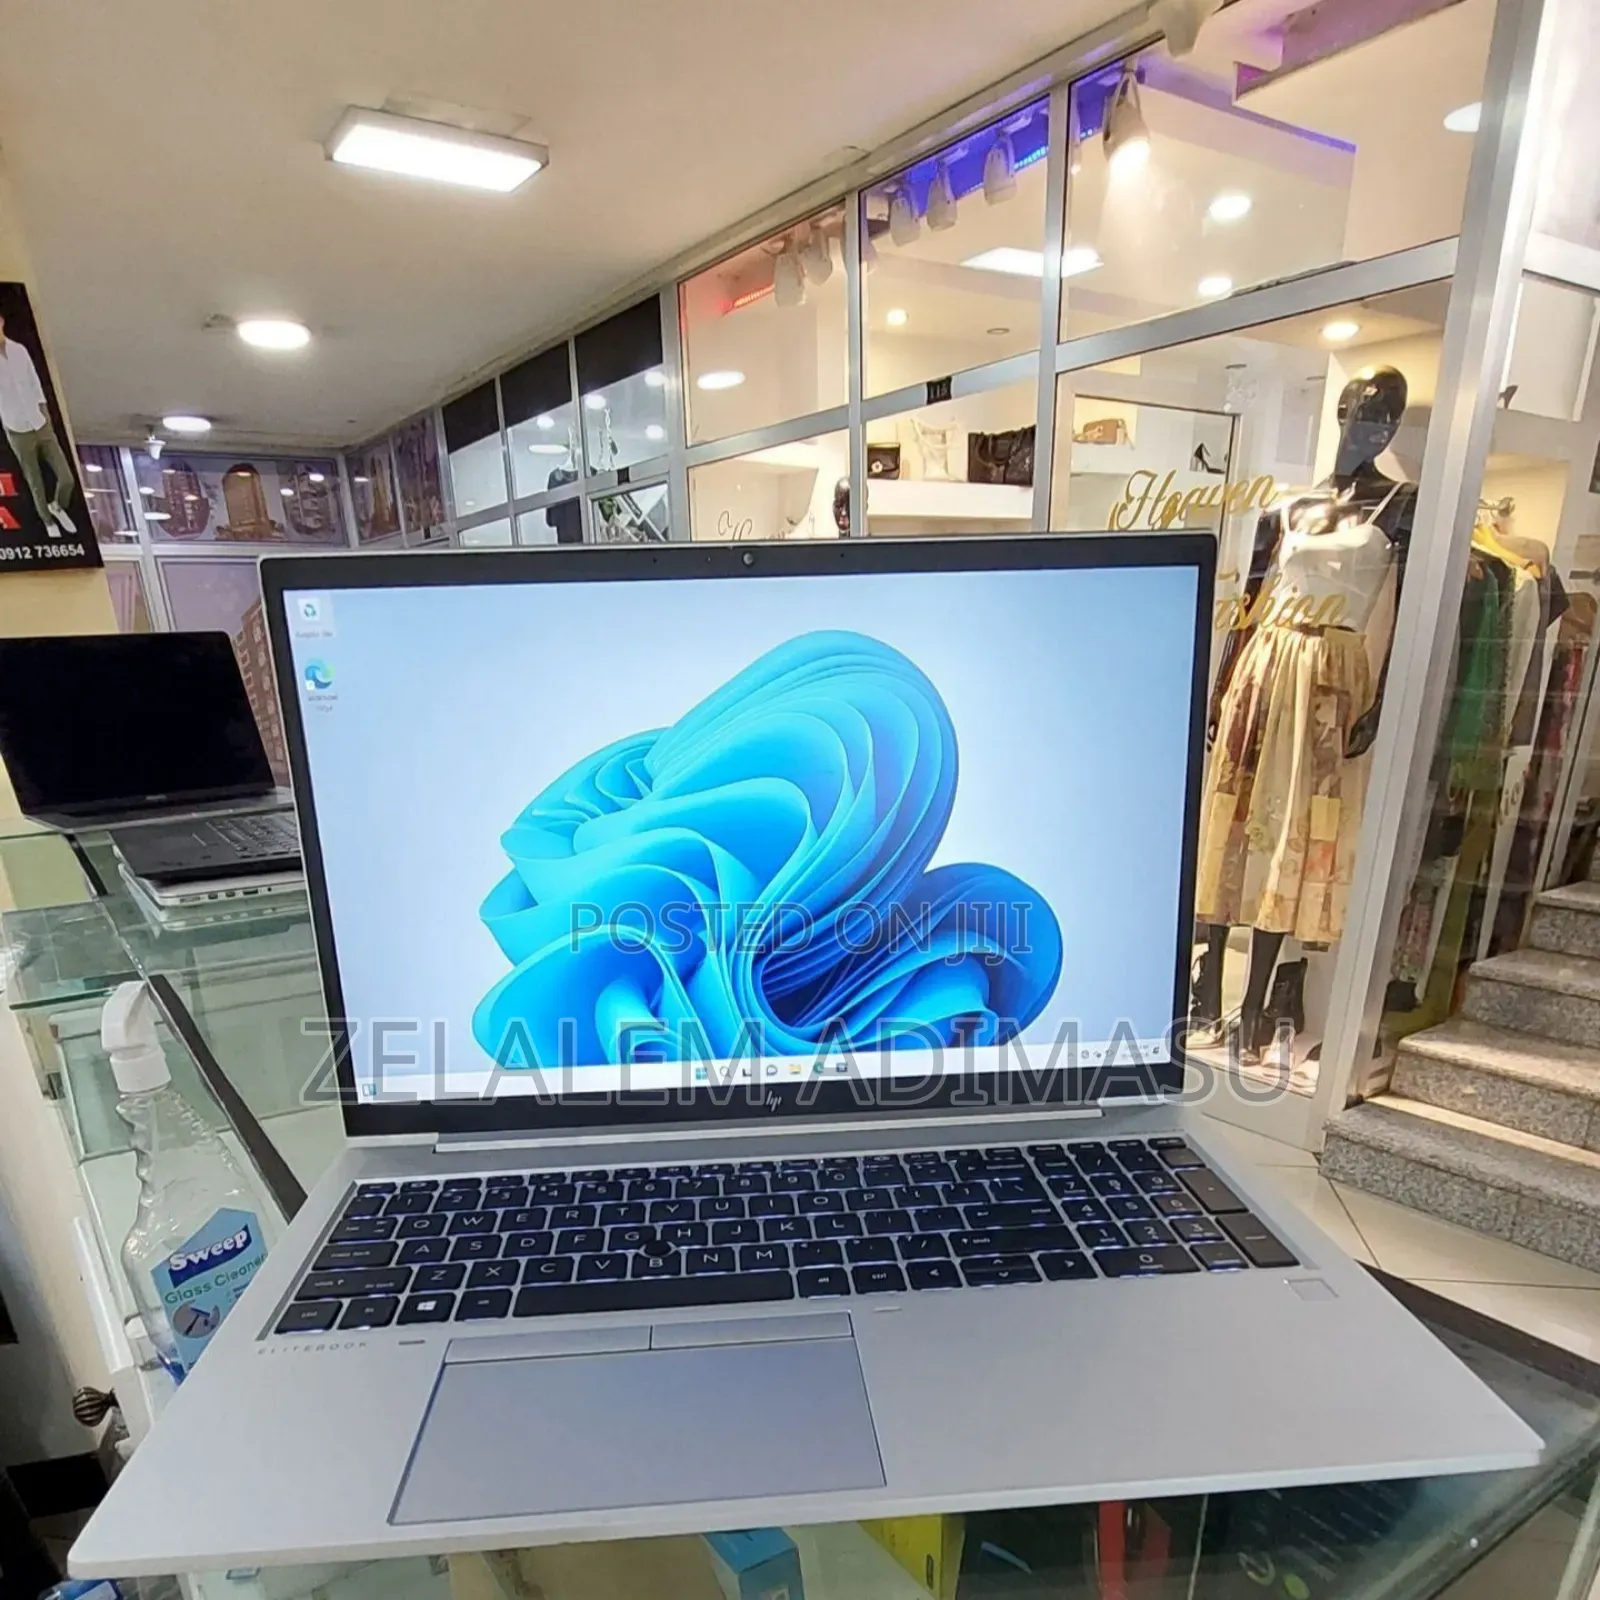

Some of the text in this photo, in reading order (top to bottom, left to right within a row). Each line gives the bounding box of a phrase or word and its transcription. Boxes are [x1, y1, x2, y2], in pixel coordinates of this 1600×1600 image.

[34, 543, 85, 558] 736654
[169, 1229, 248, 1271] Sweep
[164, 1284, 213, 1305] Glass
